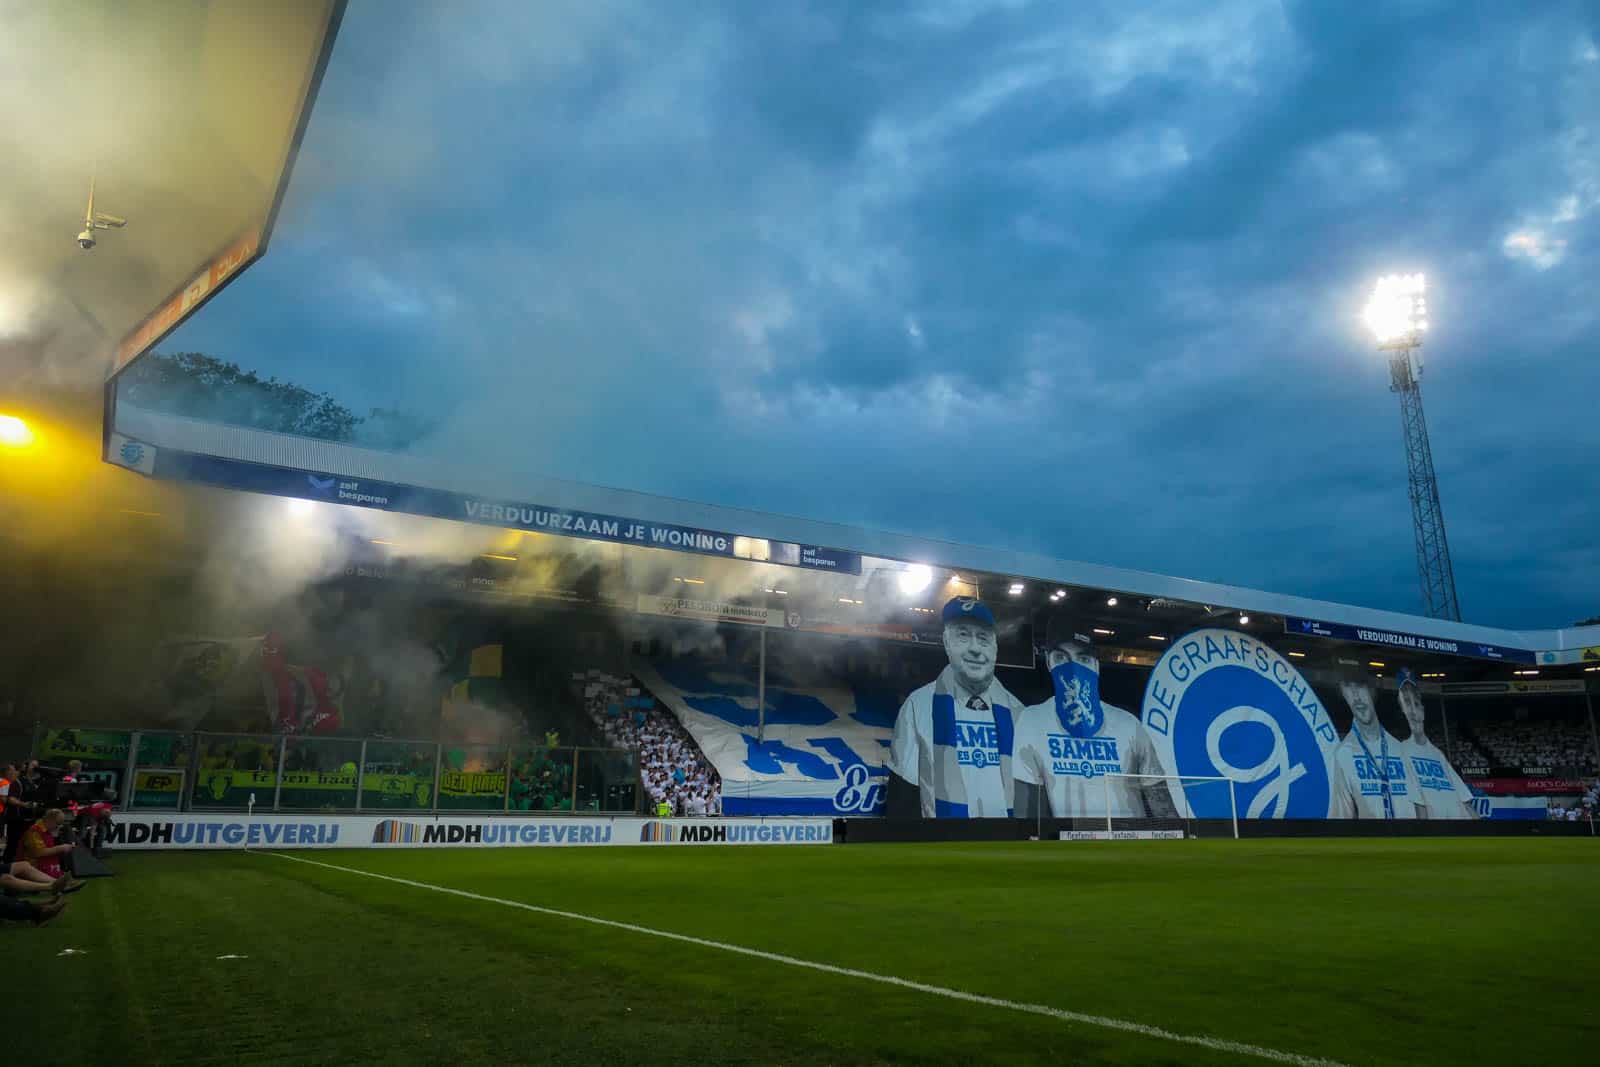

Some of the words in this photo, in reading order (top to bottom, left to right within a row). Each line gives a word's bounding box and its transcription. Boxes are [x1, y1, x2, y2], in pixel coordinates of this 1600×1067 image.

[338, 489, 388, 504] besparen
[340, 481, 359, 491] zelf
[464, 500, 618, 537] VERDUURZAAM
[624, 525, 645, 540] JE
[650, 527, 727, 551] WONING
[1357, 629, 1416, 647] VERDUURZAAM
[1417, 638, 1426, 648] JE
[1426, 639, 1458, 653] WONING
[1147, 680, 1176, 736] DE
[1168, 635, 1335, 743] GRAAFSCHAP
[956, 725, 998, 748] AME
[1048, 738, 1120, 760] SAMEN
[1053, 761, 1079, 771] ALLES
[1354, 759, 1406, 780] SAEN
[105, 822, 340, 844] MDHUITGEVERIJ
[422, 824, 613, 844] MDHUITGEVERIJ
[679, 825, 832, 842] MDHUITGEVERIJ
